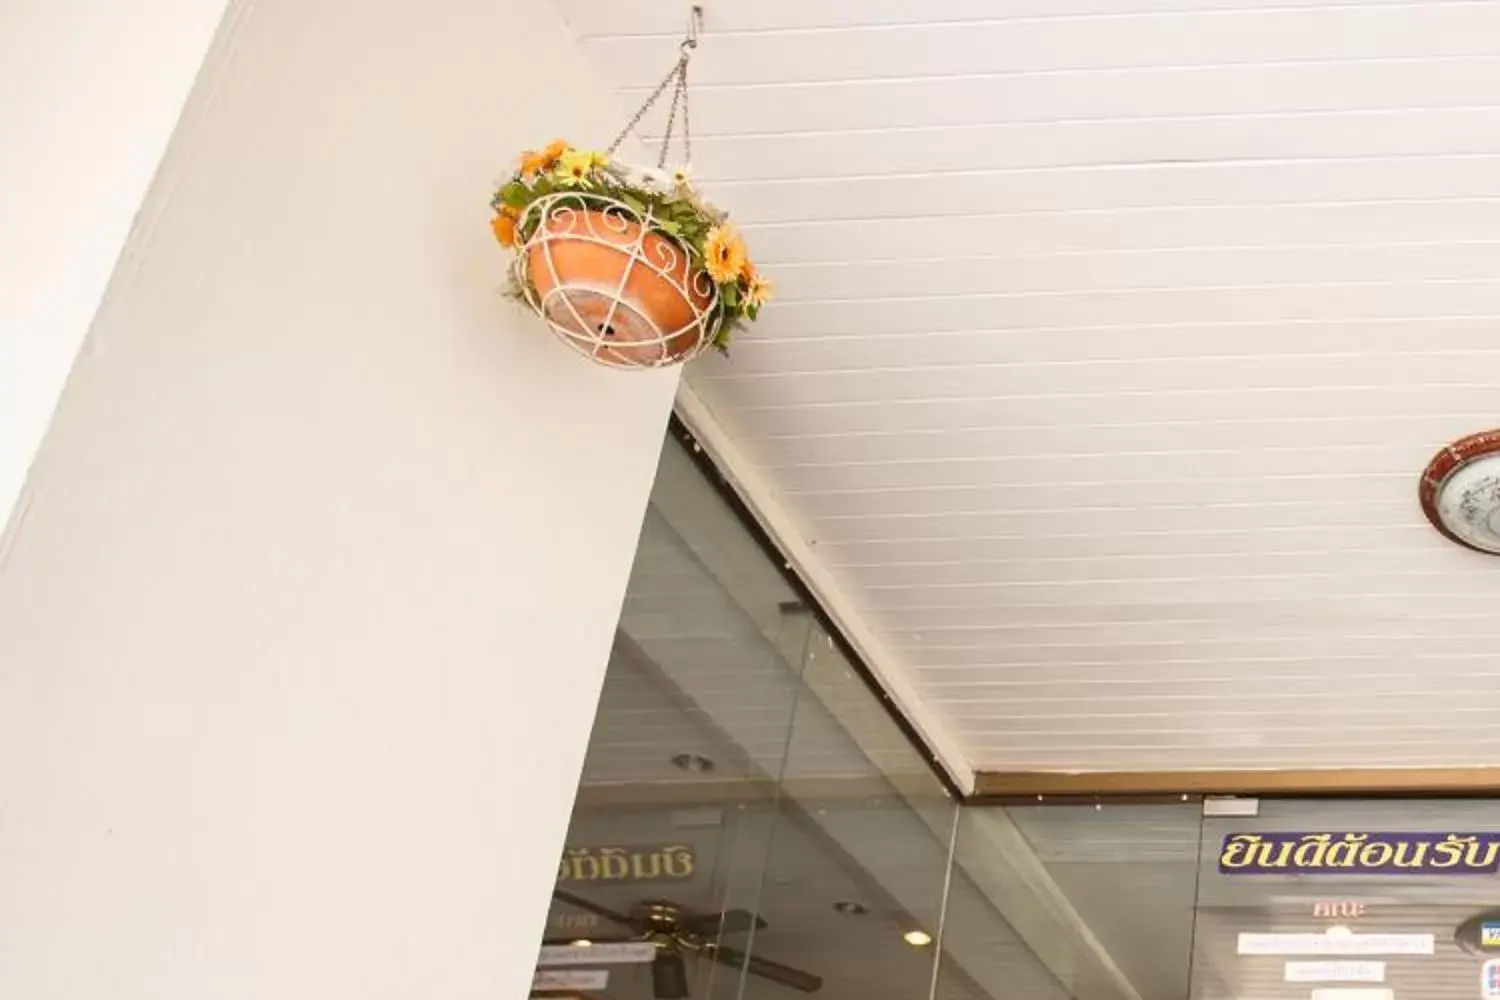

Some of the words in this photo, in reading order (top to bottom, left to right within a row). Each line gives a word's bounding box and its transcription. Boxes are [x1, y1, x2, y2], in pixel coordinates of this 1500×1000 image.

[1220, 833, 1500, 868] ยินดีต้อนรับ
